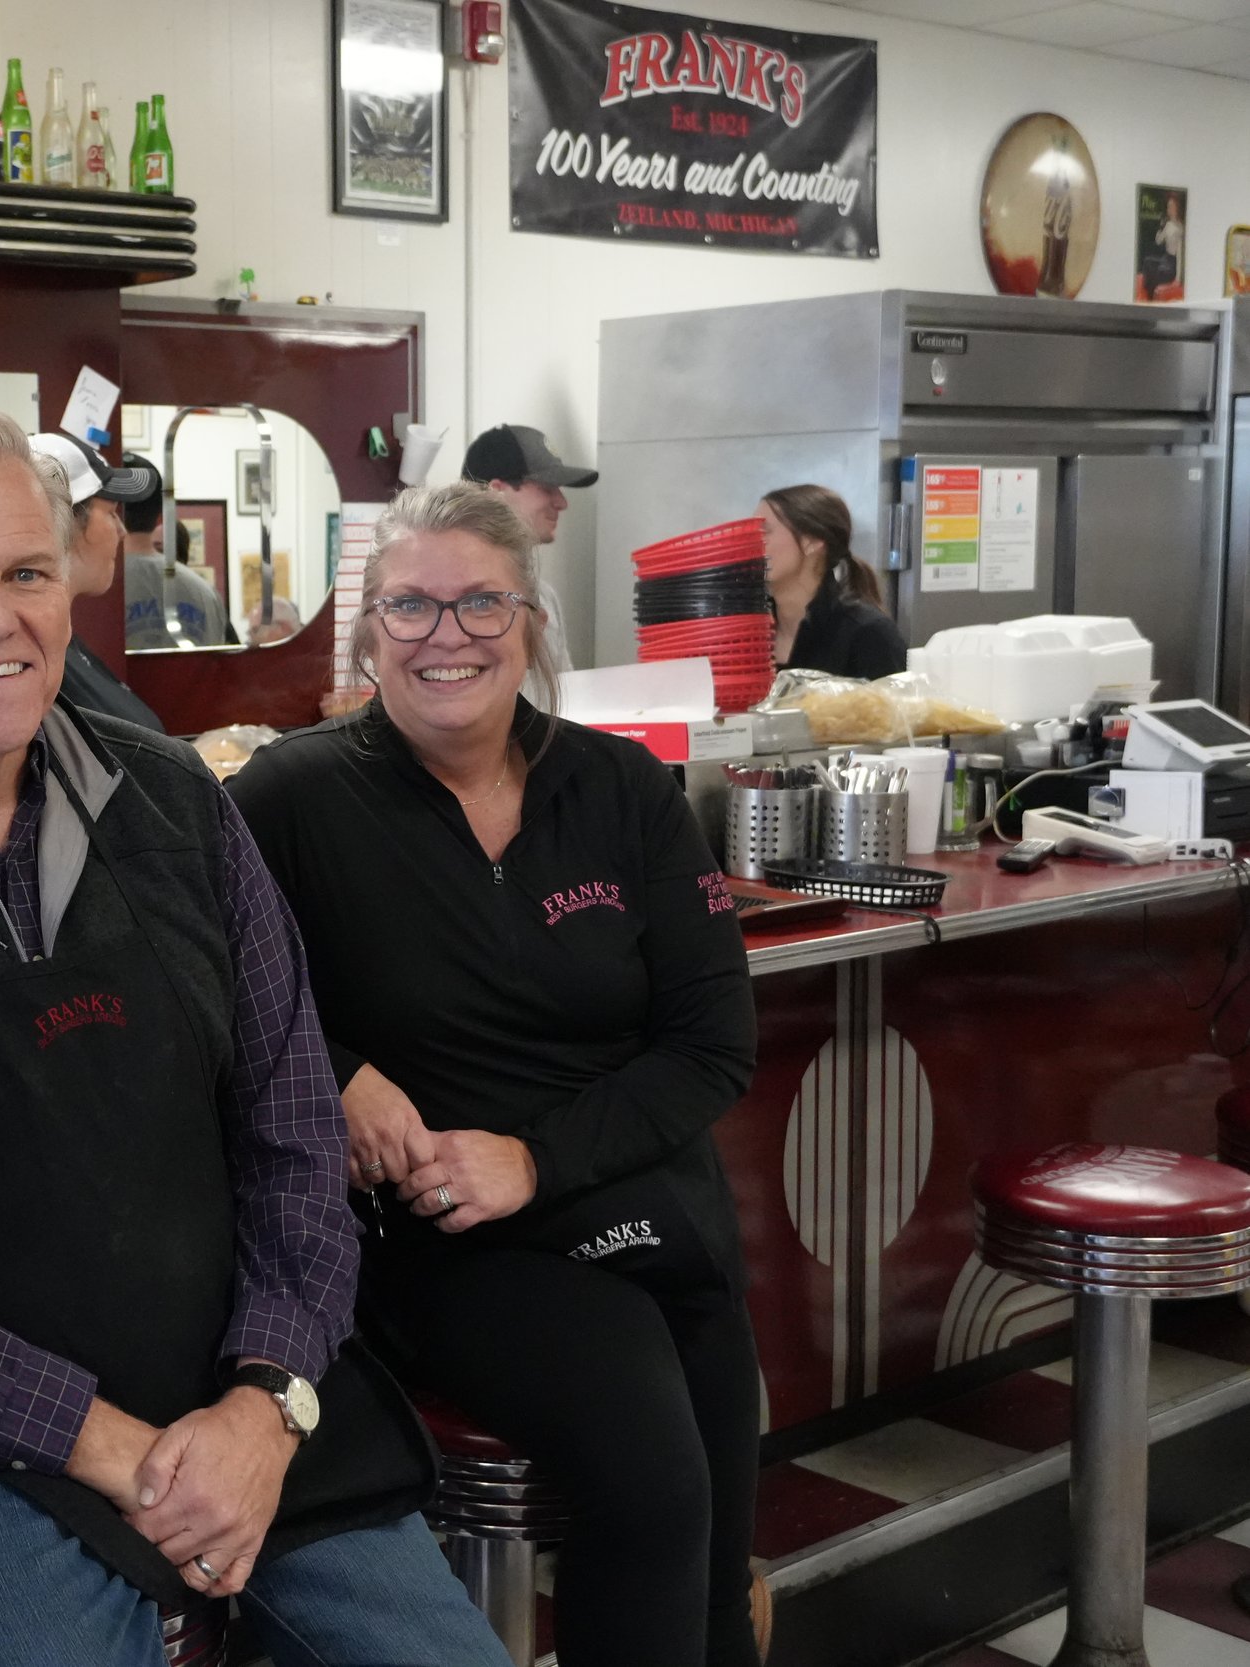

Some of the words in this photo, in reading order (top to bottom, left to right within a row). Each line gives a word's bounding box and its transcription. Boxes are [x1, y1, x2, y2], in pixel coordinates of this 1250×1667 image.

[600, 31, 807, 127] FRANK'S
[669, 104, 700, 132] Est.
[708, 111, 749, 138] 1924
[536, 128, 593, 177] 100
[594, 133, 678, 191] Years
[683, 152, 745, 198] and
[743, 152, 860, 217] Counting
[616, 203, 702, 232] ZEELAND,
[704, 213, 799, 237] MICHIGAN
[916, 332, 964, 348] Continental
[541, 881, 620, 915] FRANK'S
[546, 909, 564, 926] BEST
[564, 897, 598, 914] BURGERS
[34, 993, 125, 1035] FRANK'S
[567, 1219, 651, 1260] FRANK'S
[628, 1235, 661, 1247] AROUND
